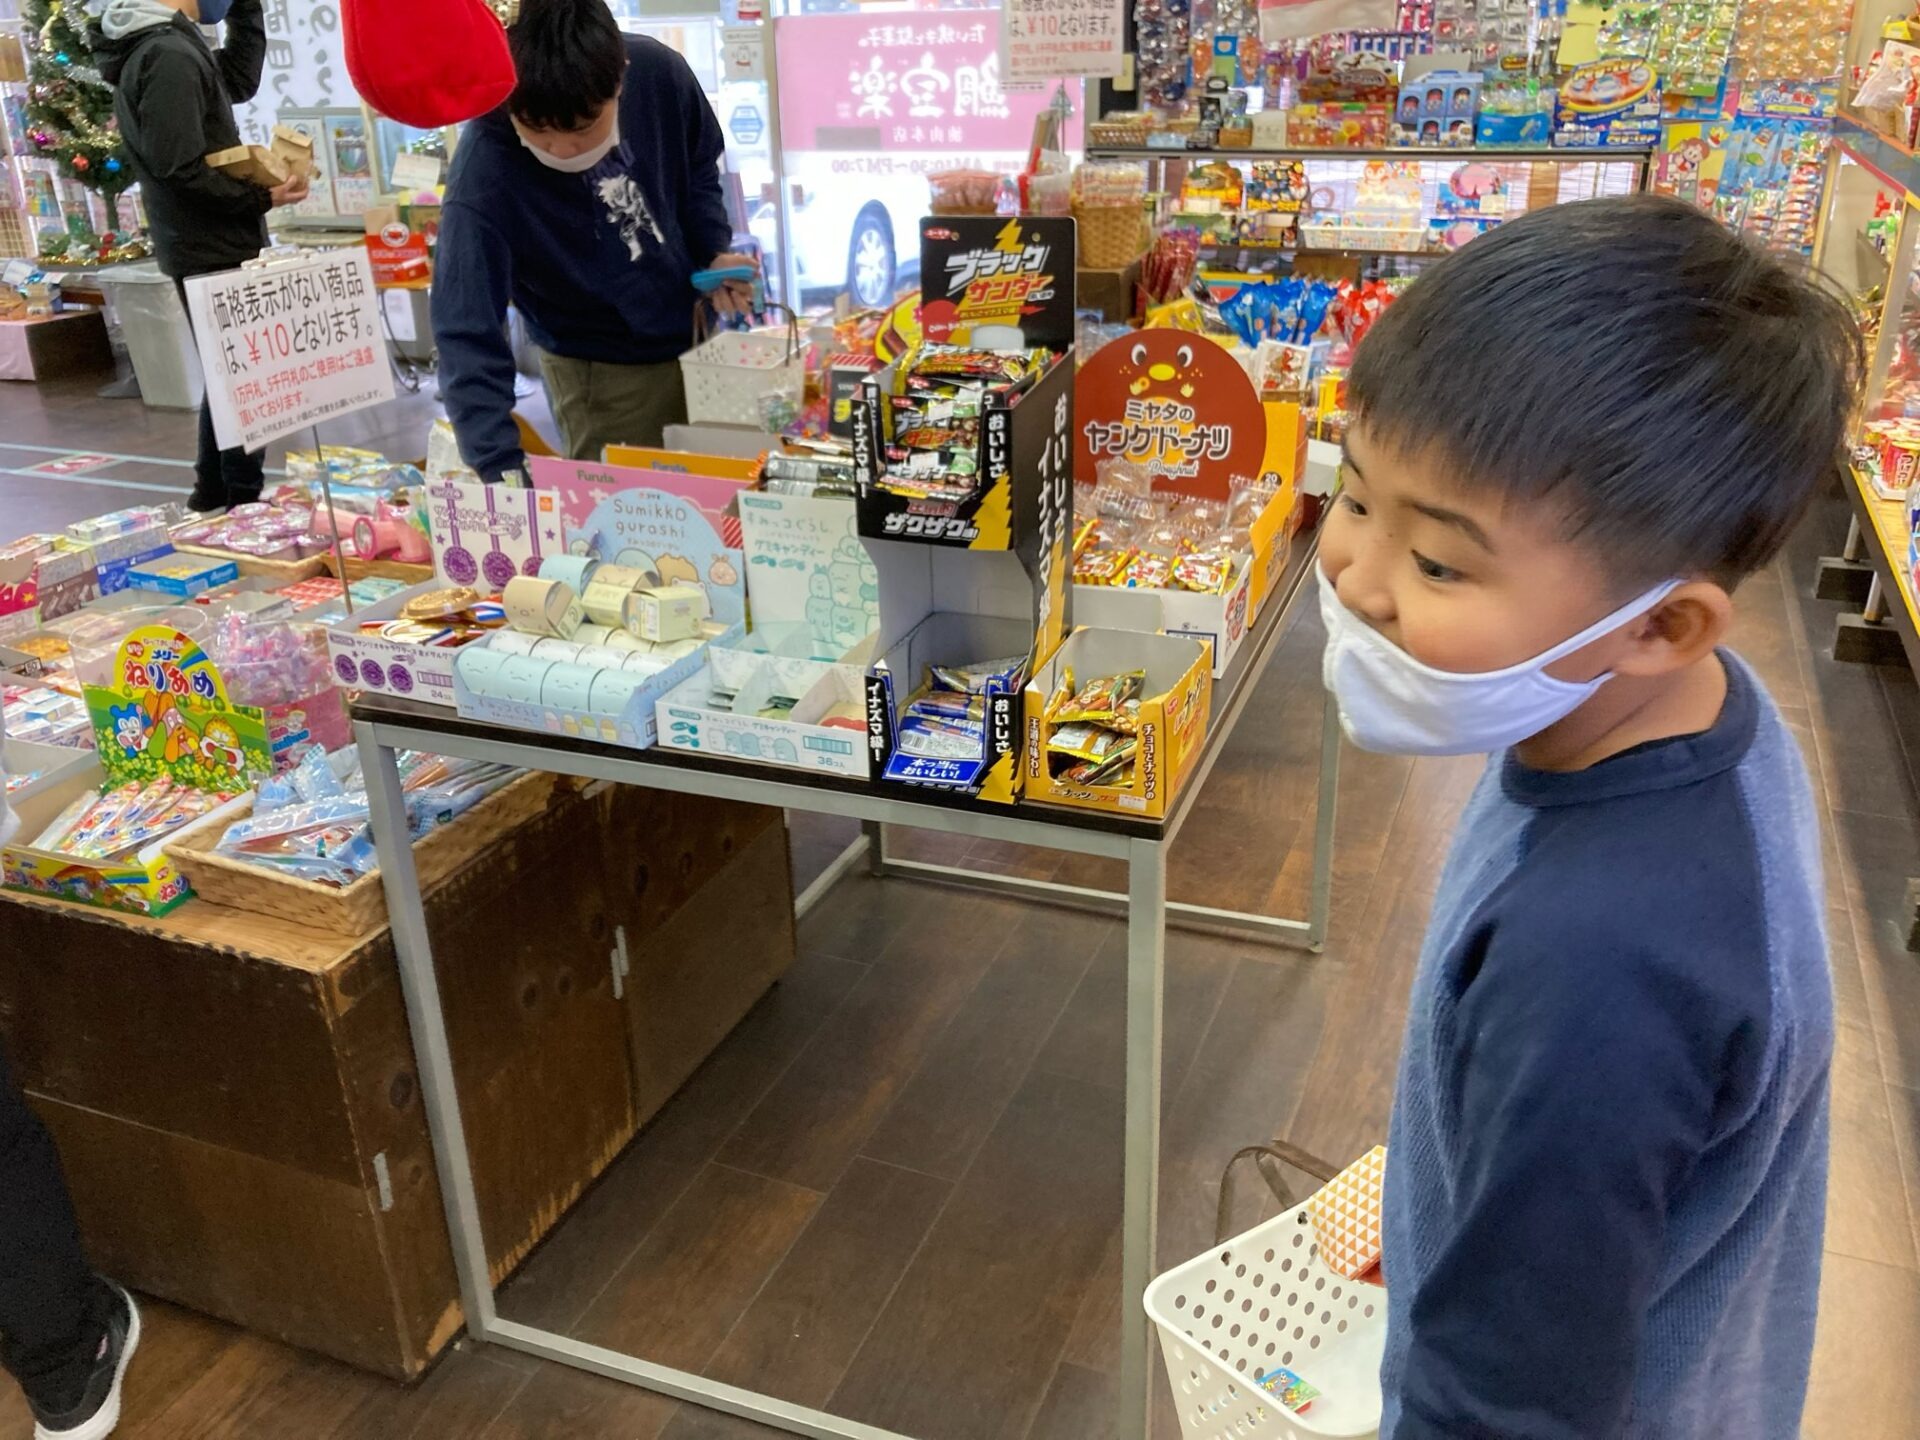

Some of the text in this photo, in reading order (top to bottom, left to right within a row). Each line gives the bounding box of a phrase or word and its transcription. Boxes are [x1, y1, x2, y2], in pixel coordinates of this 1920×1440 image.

[944, 245, 1051, 297] ブラック
[212, 261, 364, 333] 価格表示がない商品
[221, 303, 374, 376] は、¥10となります。
[1126, 399, 1195, 423] ミヤタの
[988, 414, 1007, 479] おいしさ
[1084, 421, 1232, 460] ヤングドーナツ
[616, 521, 686, 538] gurashi
[124, 658, 216, 699] ねりあめ
[995, 698, 1011, 753] おいしさ
[901, 767, 960, 779] おいしい！
[911, 758, 960, 770] 本っ当に
[1143, 724, 1157, 800] チョコとナッツの
